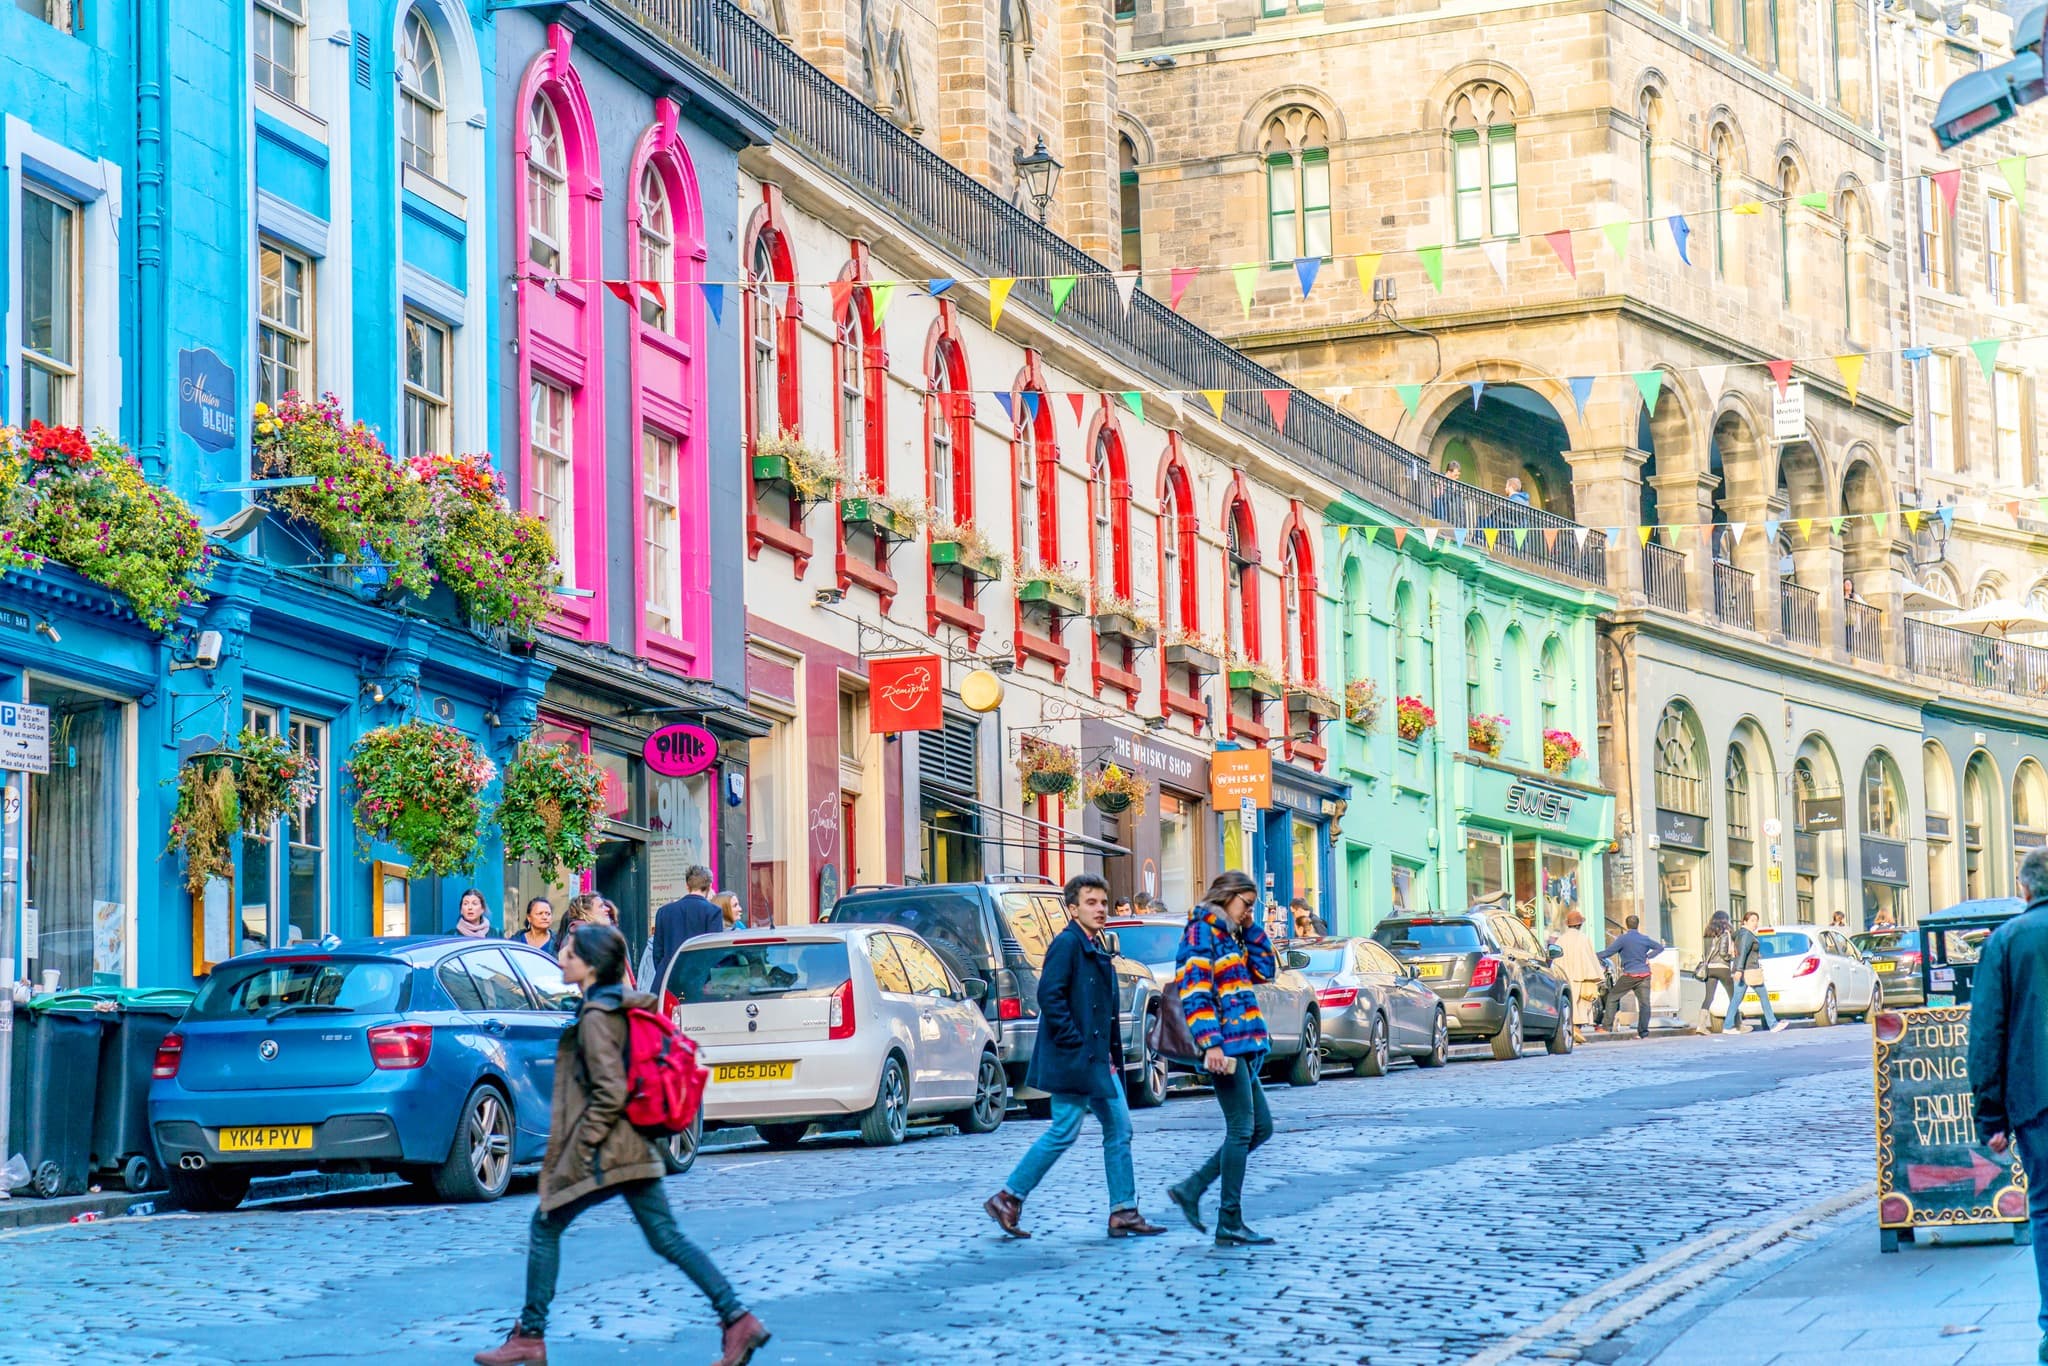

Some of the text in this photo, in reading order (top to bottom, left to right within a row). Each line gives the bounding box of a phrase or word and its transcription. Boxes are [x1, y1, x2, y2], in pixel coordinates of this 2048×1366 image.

[181, 372, 220, 408] Maison
[203, 406, 236, 437] BLEUE
[880, 682, 930, 700] Demijohn
[21, 733, 44, 741] machine
[5, 750, 26, 759] Display
[1113, 735, 1192, 778] THE WHISKY SHOP
[1217, 773, 1266, 786] WHISKY
[1228, 787, 1254, 795] SHOP
[1506, 783, 1573, 824] SWISH
[719, 1064, 788, 1080] DC65 DGY
[230, 1128, 301, 1147] YK14 PYV
